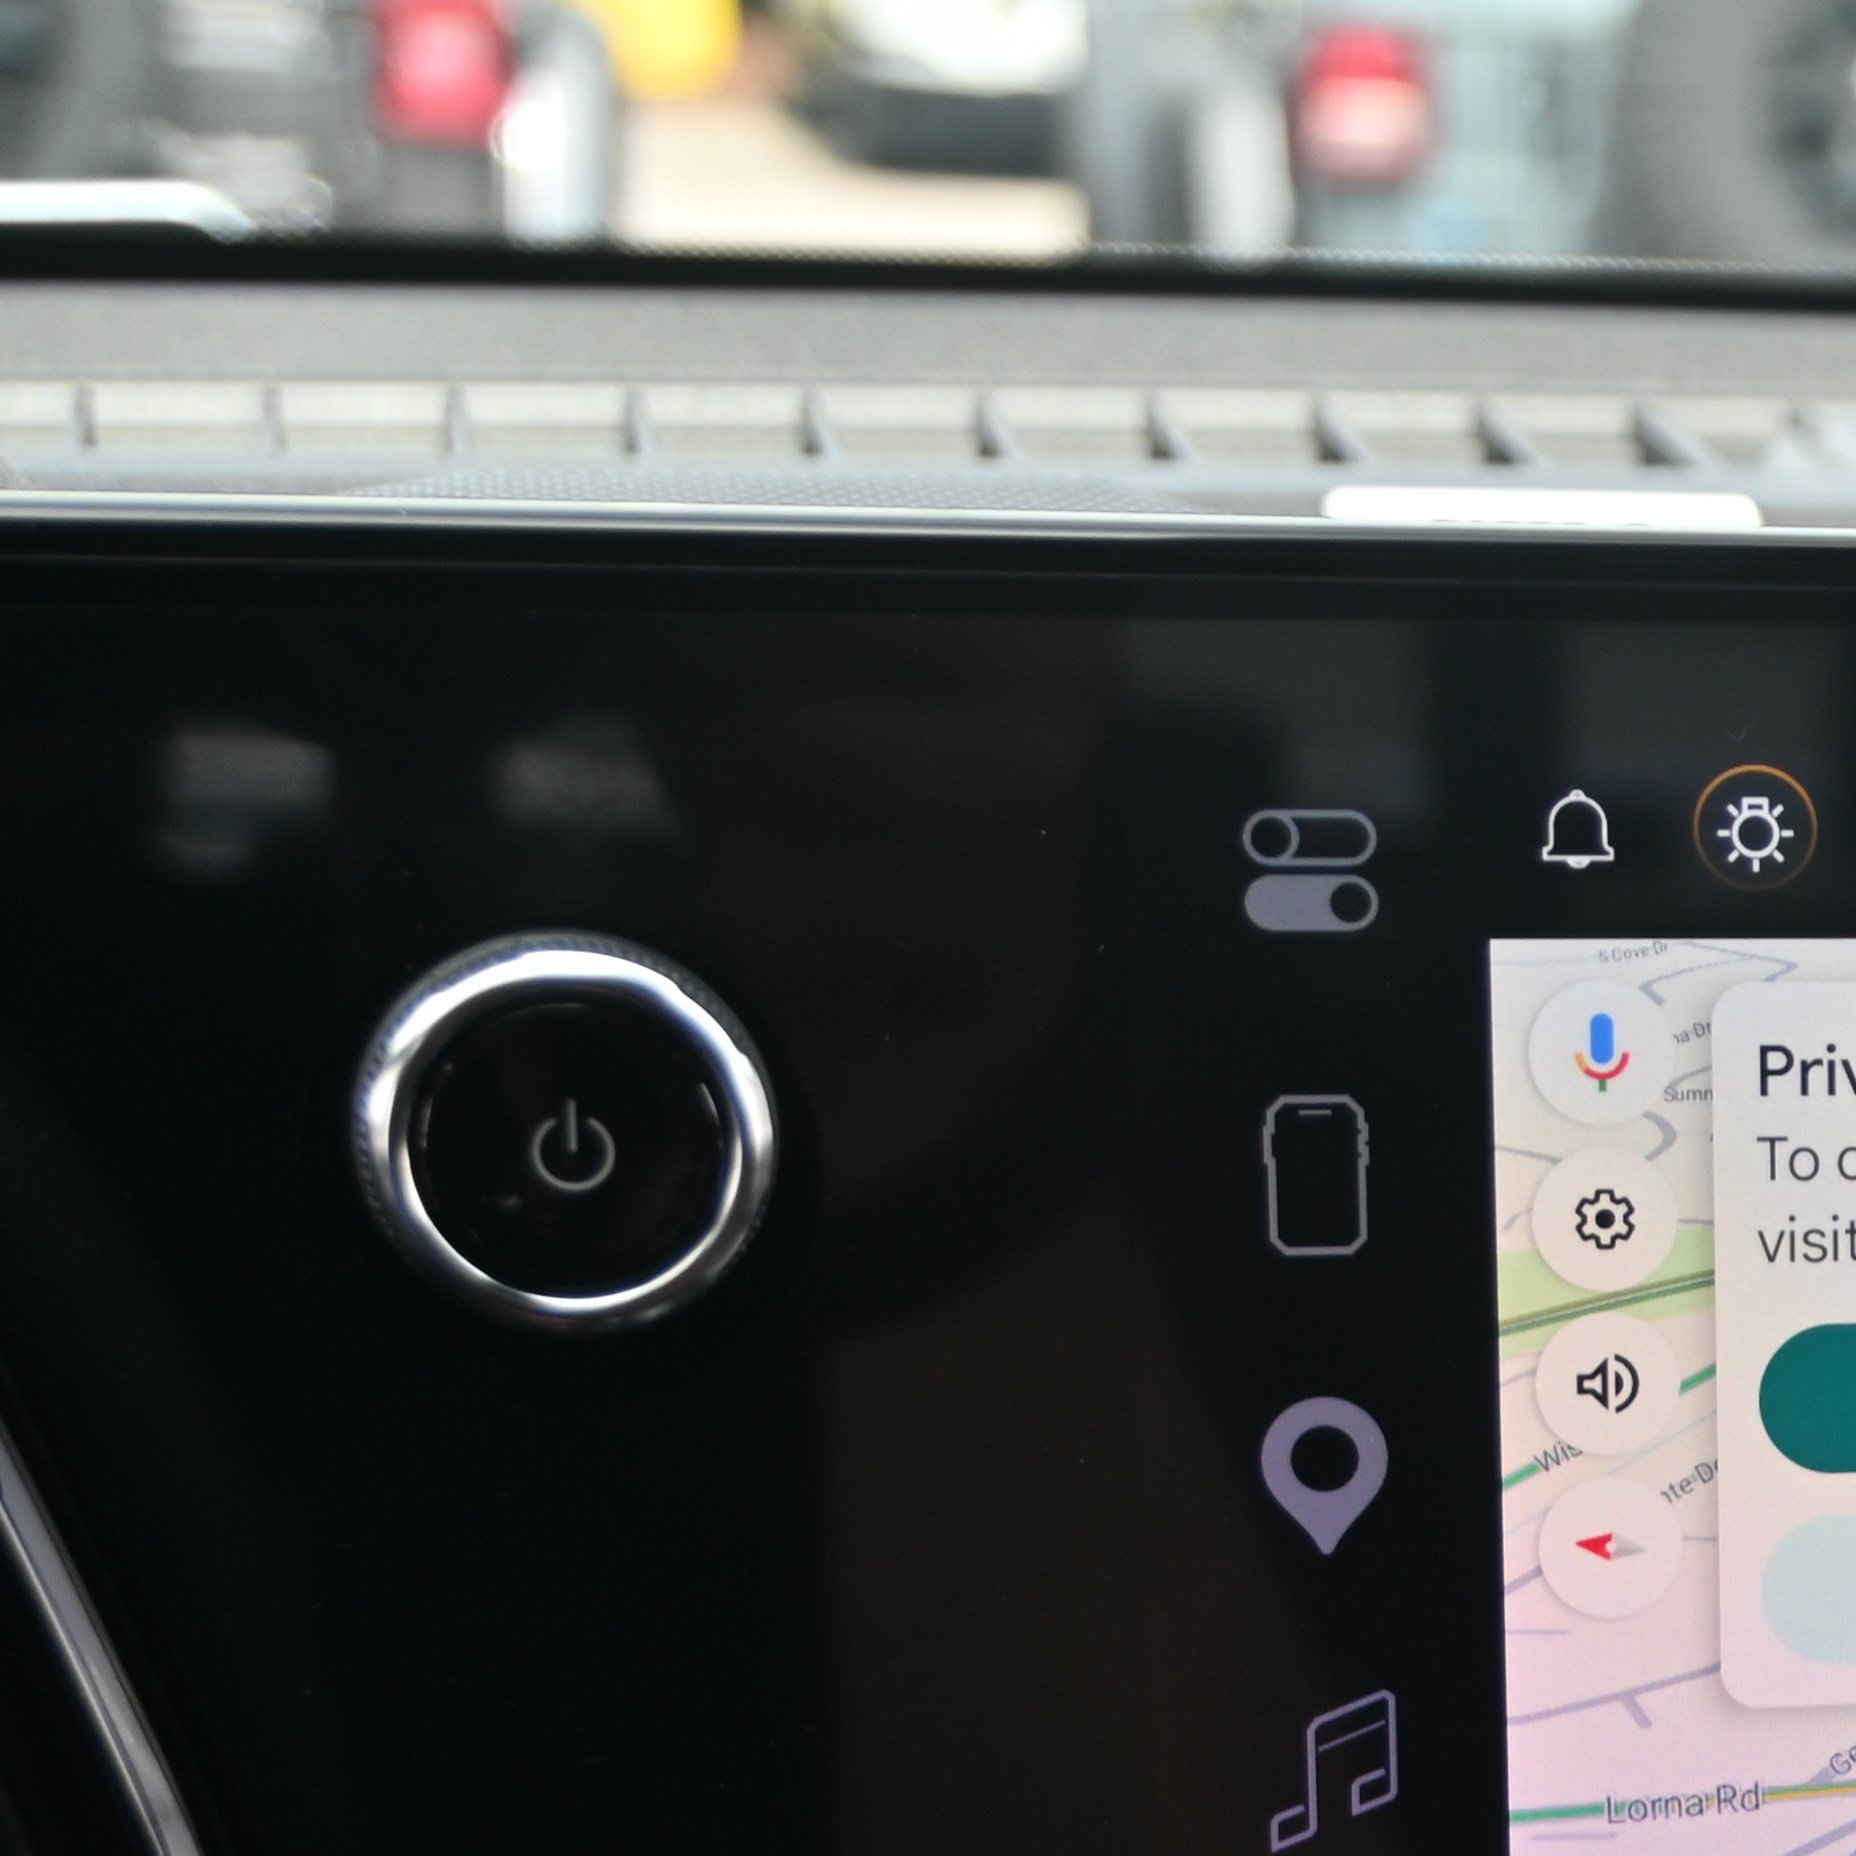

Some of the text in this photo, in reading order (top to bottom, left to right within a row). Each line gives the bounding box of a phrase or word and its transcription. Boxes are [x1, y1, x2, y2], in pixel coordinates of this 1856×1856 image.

[1653, 940, 1669, 955] Dr
[1757, 1136, 1821, 1181] To
[1606, 1780, 1764, 1825] Lorna Rd
